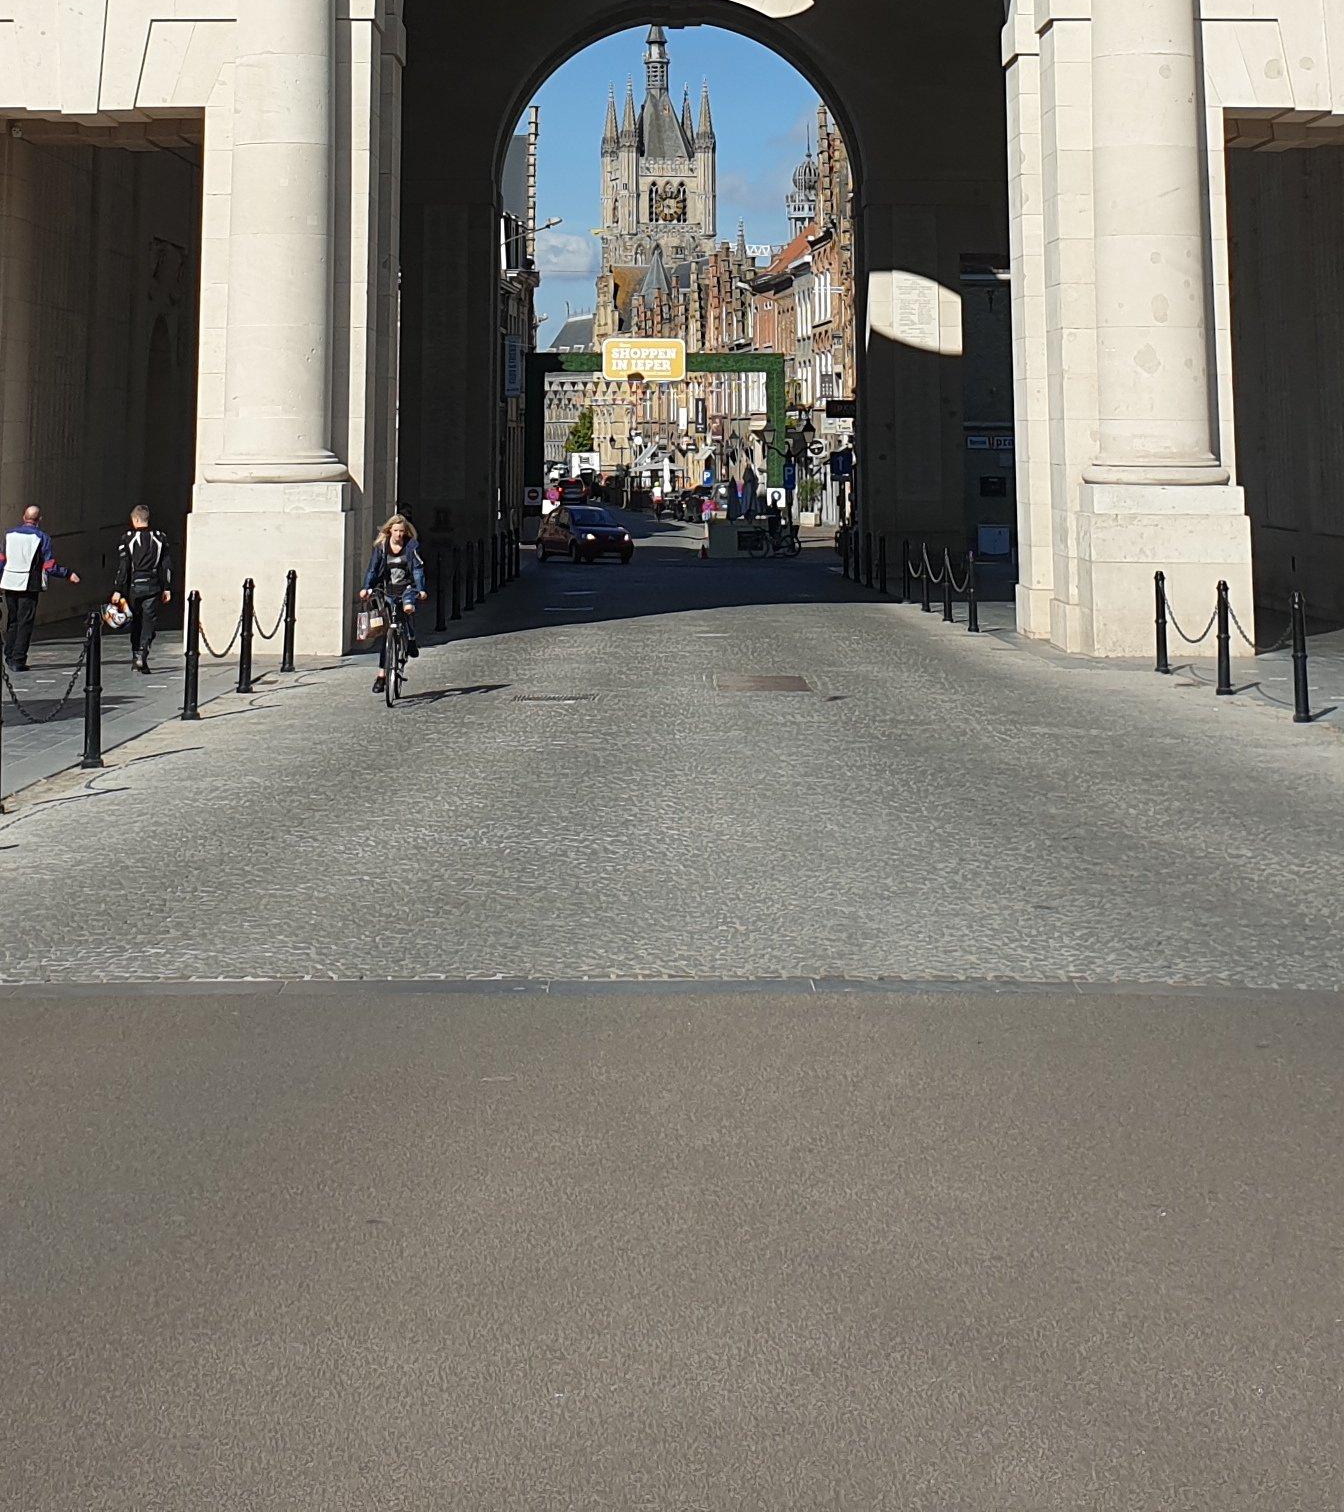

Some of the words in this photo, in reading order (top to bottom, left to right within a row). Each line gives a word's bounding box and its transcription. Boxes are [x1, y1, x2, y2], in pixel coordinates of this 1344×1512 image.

[611, 347, 676, 359] SHOPPEN
[612, 359, 628, 371] IN
[630, 359, 672, 371] IEPER
